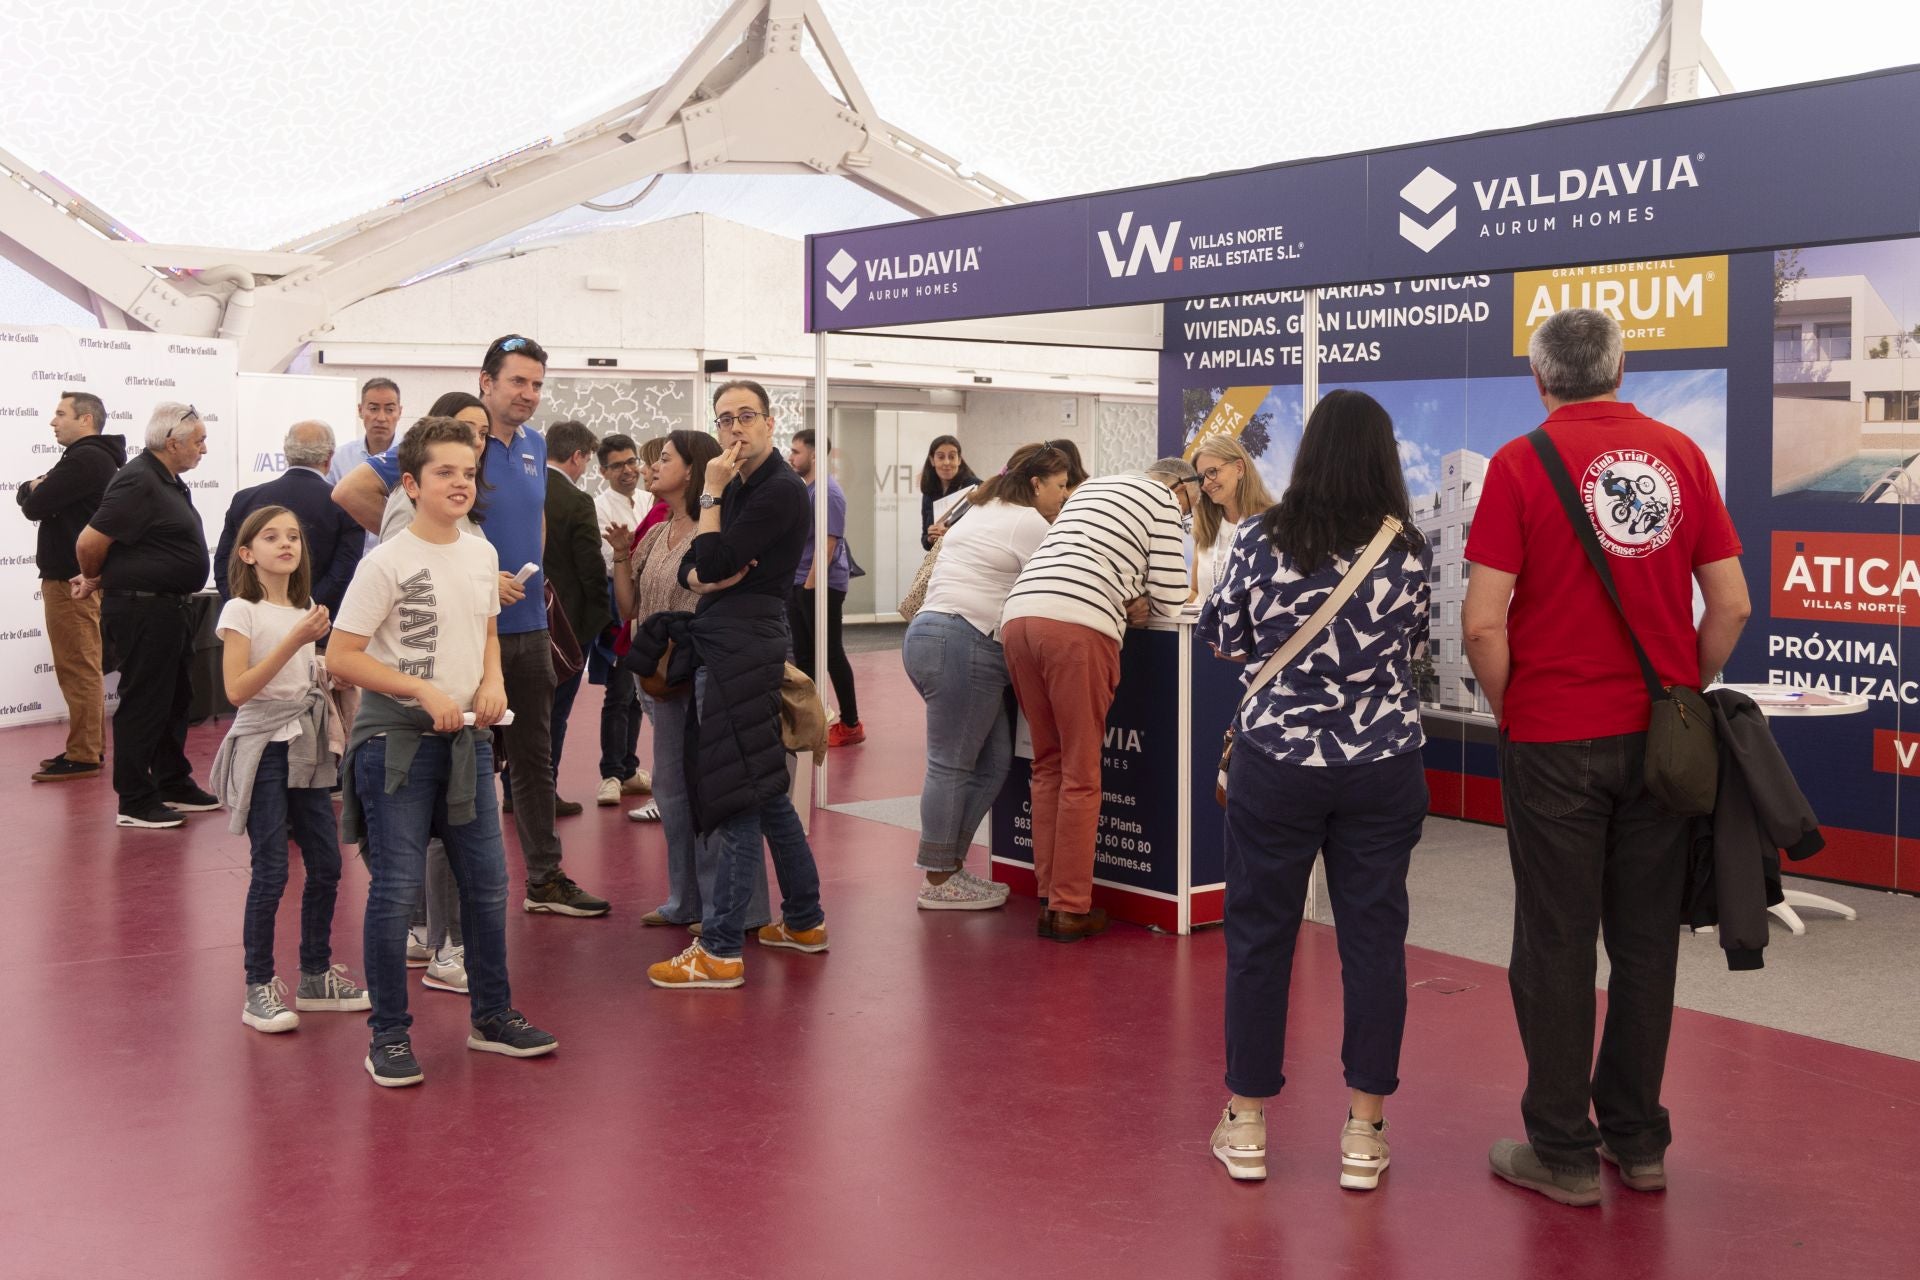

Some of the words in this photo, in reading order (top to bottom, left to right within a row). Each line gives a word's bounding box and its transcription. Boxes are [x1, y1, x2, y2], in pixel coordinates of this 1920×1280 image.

[1480, 217, 1556, 238] AURUM
[1573, 206, 1655, 228] HOMES
[1189, 232, 1234, 250] VILLAS
[1237, 226, 1283, 245] NORTE
[1189, 253, 1223, 269] REAL
[1226, 247, 1273, 266] ESTATE
[1552, 267, 1584, 278] GRAN
[1590, 259, 1675, 274] RESIDENCIAL
[869, 287, 909, 301] AURUM
[916, 282, 958, 296] HOMES
[1210, 283, 1386, 309] EXTRAORDNARIAS
[1394, 282, 1402, 294] Y
[1184, 317, 1281, 340] VIVIENDAS.
[1286, 311, 1340, 333] GAN
[1346, 301, 1489, 330] LUMINOSIDAD
[1184, 352, 1195, 369] Y
[1199, 347, 1275, 369] AMPLIAS
[1280, 341, 1381, 365] TERAZAS
[1224, 402, 1234, 416] A
[1583, 481, 1595, 513] Moto
[1589, 454, 1615, 477] Club
[1616, 451, 1649, 462] Trial
[1651, 459, 1680, 507] Entrimo
[1595, 530, 1636, 556] Ourense
[1803, 599, 1852, 611] VILLAS
[1857, 602, 1907, 615] NORTE
[17, 629, 41, 639] Castilla
[399, 568, 438, 680] WAVE
[1768, 632, 1898, 666] PRÓXIMA
[17, 701, 41, 713] Castilla
[1103, 727, 1142, 753] VIA
[1103, 757, 1128, 770] MES
[1102, 791, 1136, 806] mes.es
[1014, 816, 1031, 830] 983
[1105, 834, 1118, 847] 60
[1121, 837, 1135, 851] 60
[1137, 840, 1152, 854] 80
[1110, 817, 1142, 834] Planta
[1014, 836, 1033, 848] com
